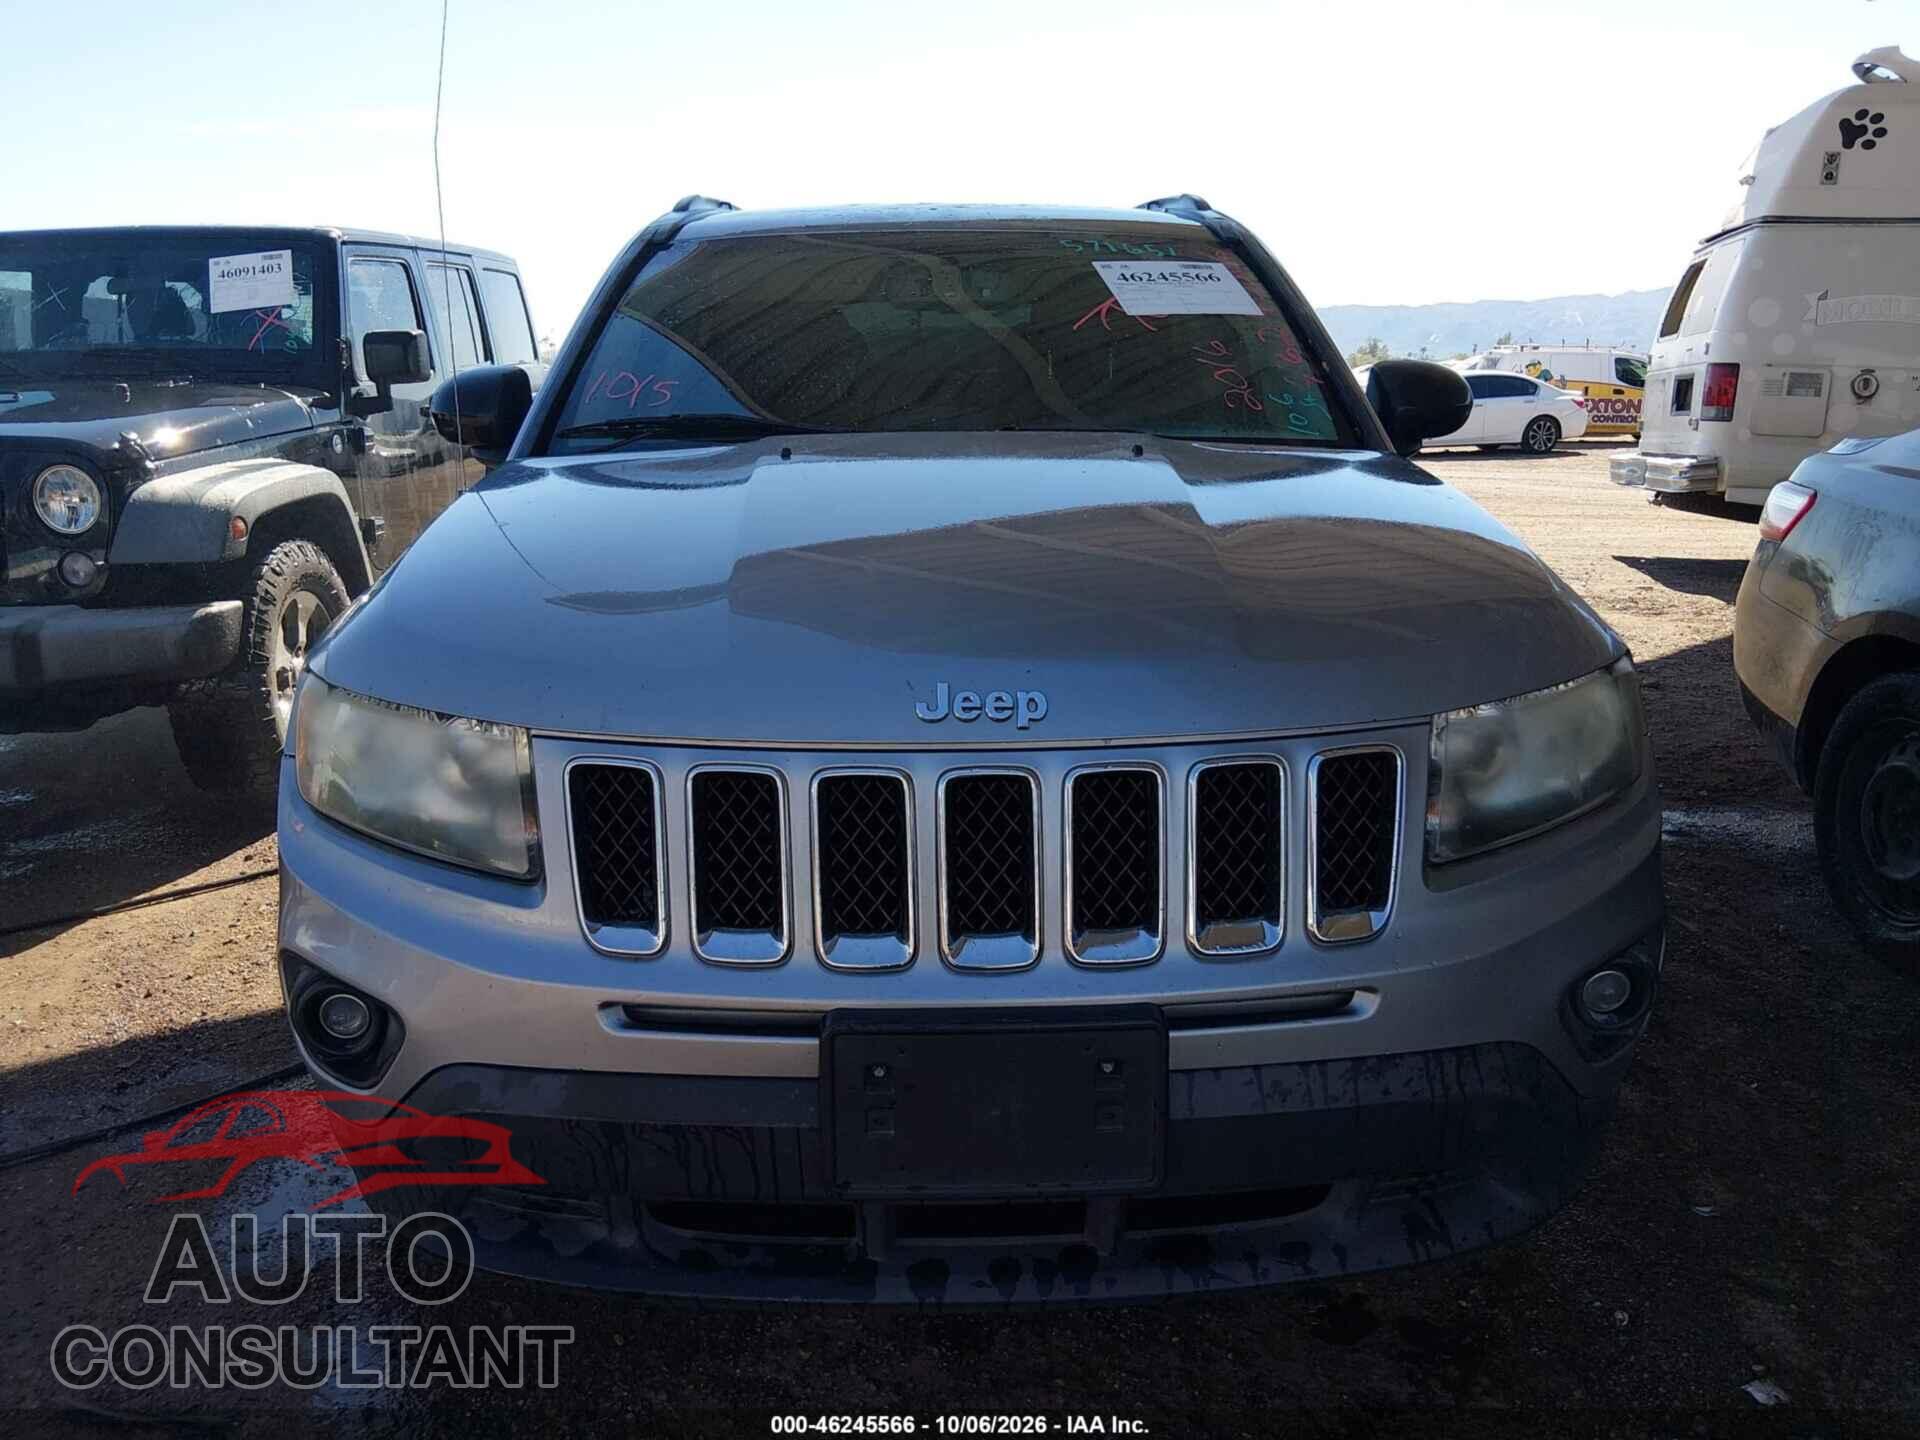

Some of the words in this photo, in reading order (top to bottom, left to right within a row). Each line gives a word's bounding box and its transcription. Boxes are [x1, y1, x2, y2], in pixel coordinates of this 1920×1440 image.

[217, 263, 283, 280] 46091403
[1116, 271, 1222, 283] 46245566
[914, 682, 1048, 730] Jeep
